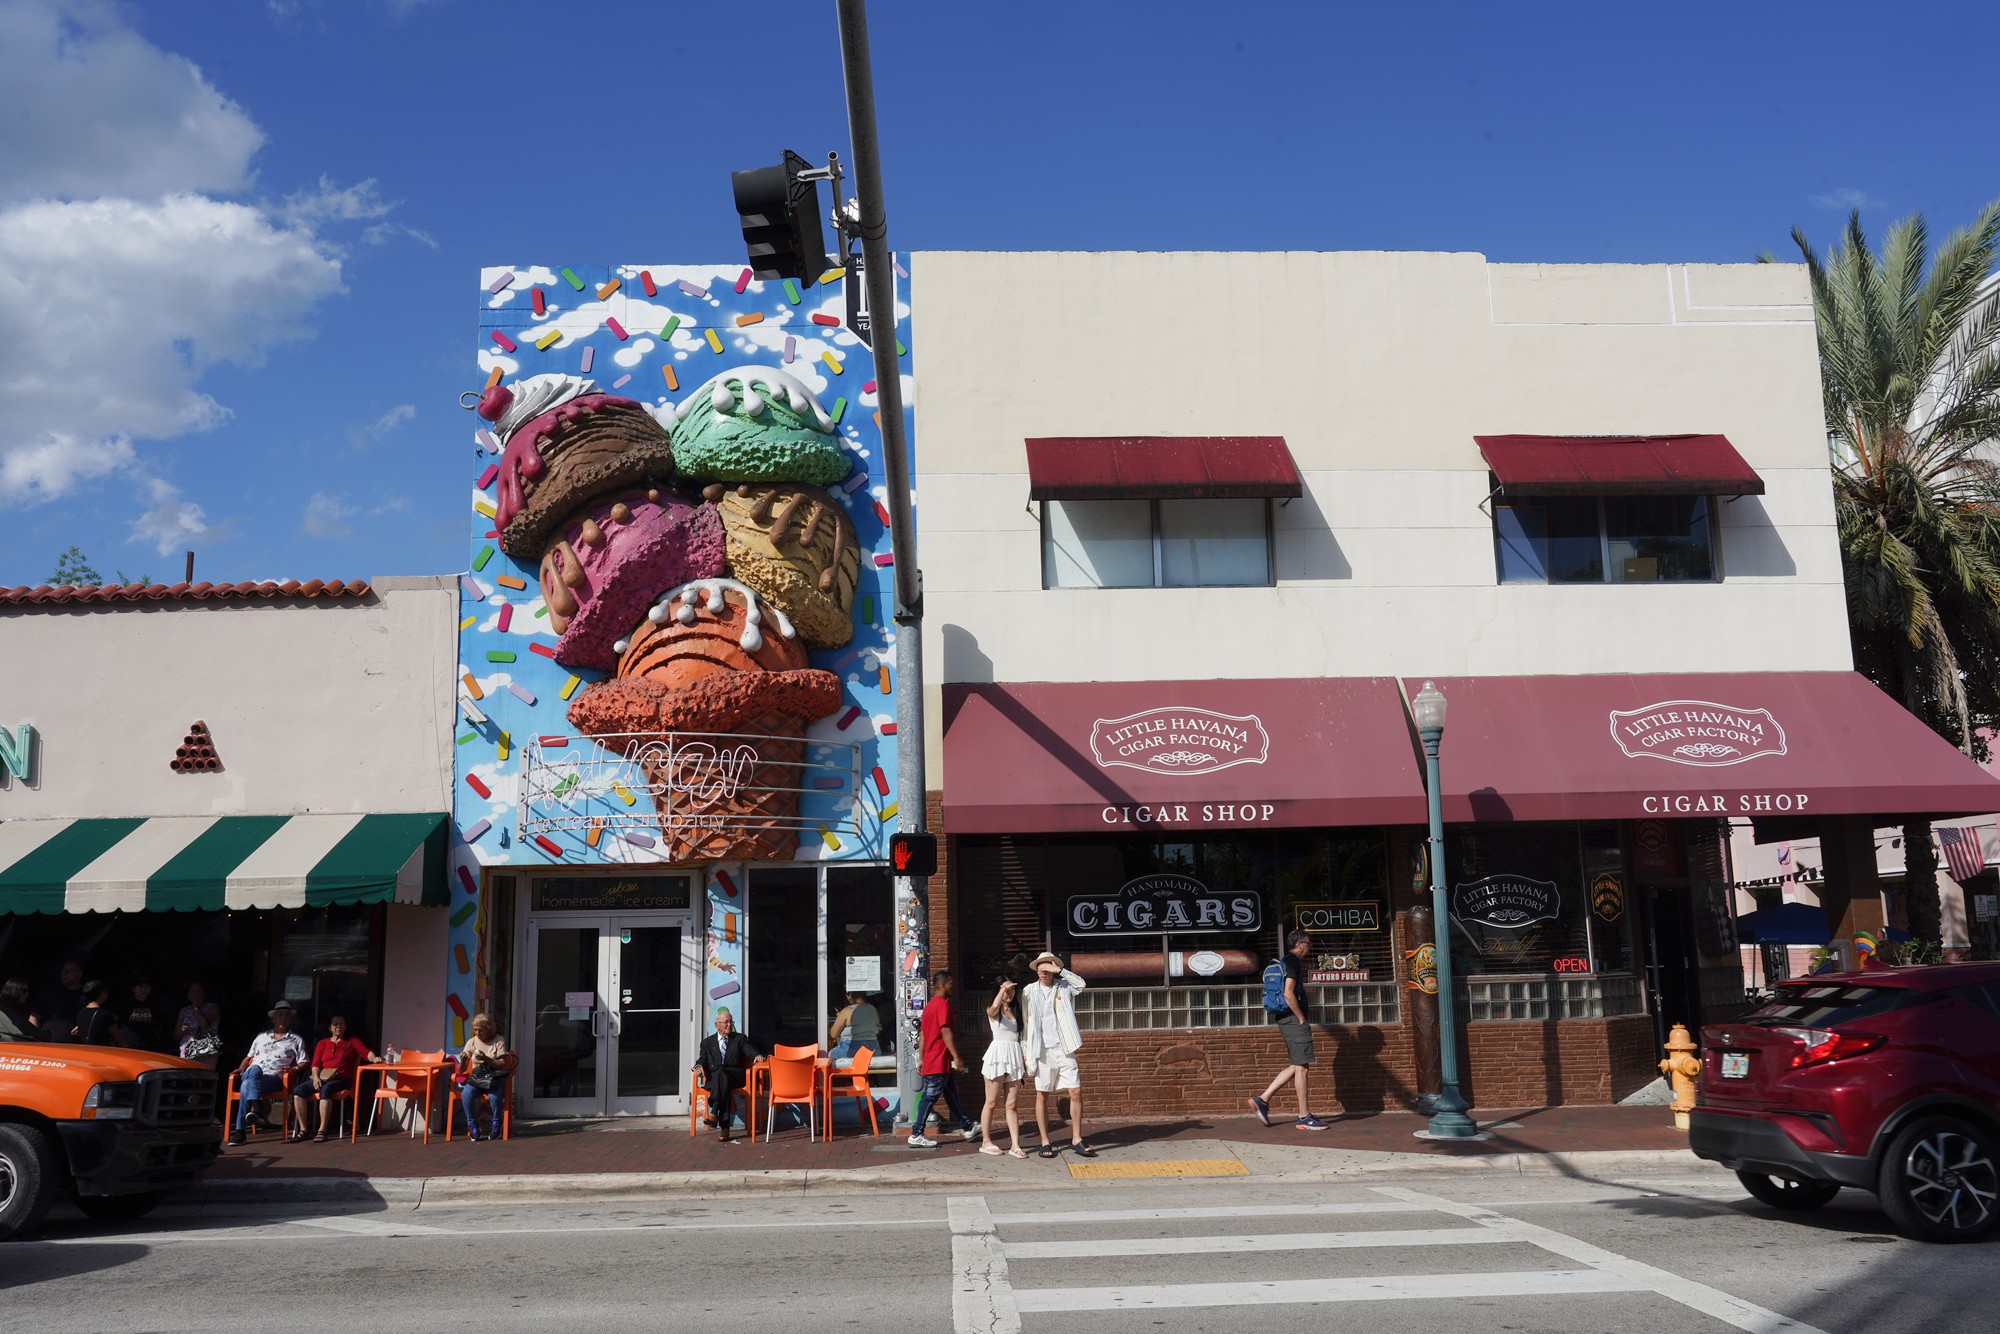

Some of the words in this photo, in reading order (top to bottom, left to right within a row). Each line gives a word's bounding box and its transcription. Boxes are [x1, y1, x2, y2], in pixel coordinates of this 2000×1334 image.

[1105, 719, 1167, 746] LITTLE
[1171, 718, 1249, 743] HAVANA
[1625, 711, 1682, 737] LITTLE
[1684, 711, 1764, 736] HAVANA
[1118, 735, 1166, 757] CIGAR
[1169, 734, 1244, 755] FACTORY
[1641, 727, 1686, 748] CIGAR
[1687, 726, 1762, 747] FACTORY
[1101, 805, 1190, 824] CIGAR
[1202, 804, 1275, 822] SHOP
[1642, 796, 1728, 814] CIGAR
[1740, 794, 1809, 812] SHOP
[556, 815, 611, 831] cream
[620, 813, 727, 834] company
[1127, 880, 1200, 897] HANDMADE
[1462, 884, 1499, 905] LITTLE
[1502, 883, 1549, 903] HAVANA
[542, 895, 616, 907] homemade
[623, 897, 641, 907] ice
[643, 895, 684, 906] cream
[1470, 896, 1498, 914] CIGAR
[1500, 896, 1545, 912] FACTORY
[1073, 897, 1256, 930] CIGARS
[1299, 909, 1375, 927] COHIBA
[1553, 958, 1588, 973] OPEN
[1312, 973, 1340, 981] ARTURO
[1341, 972, 1368, 981] FUENTE
